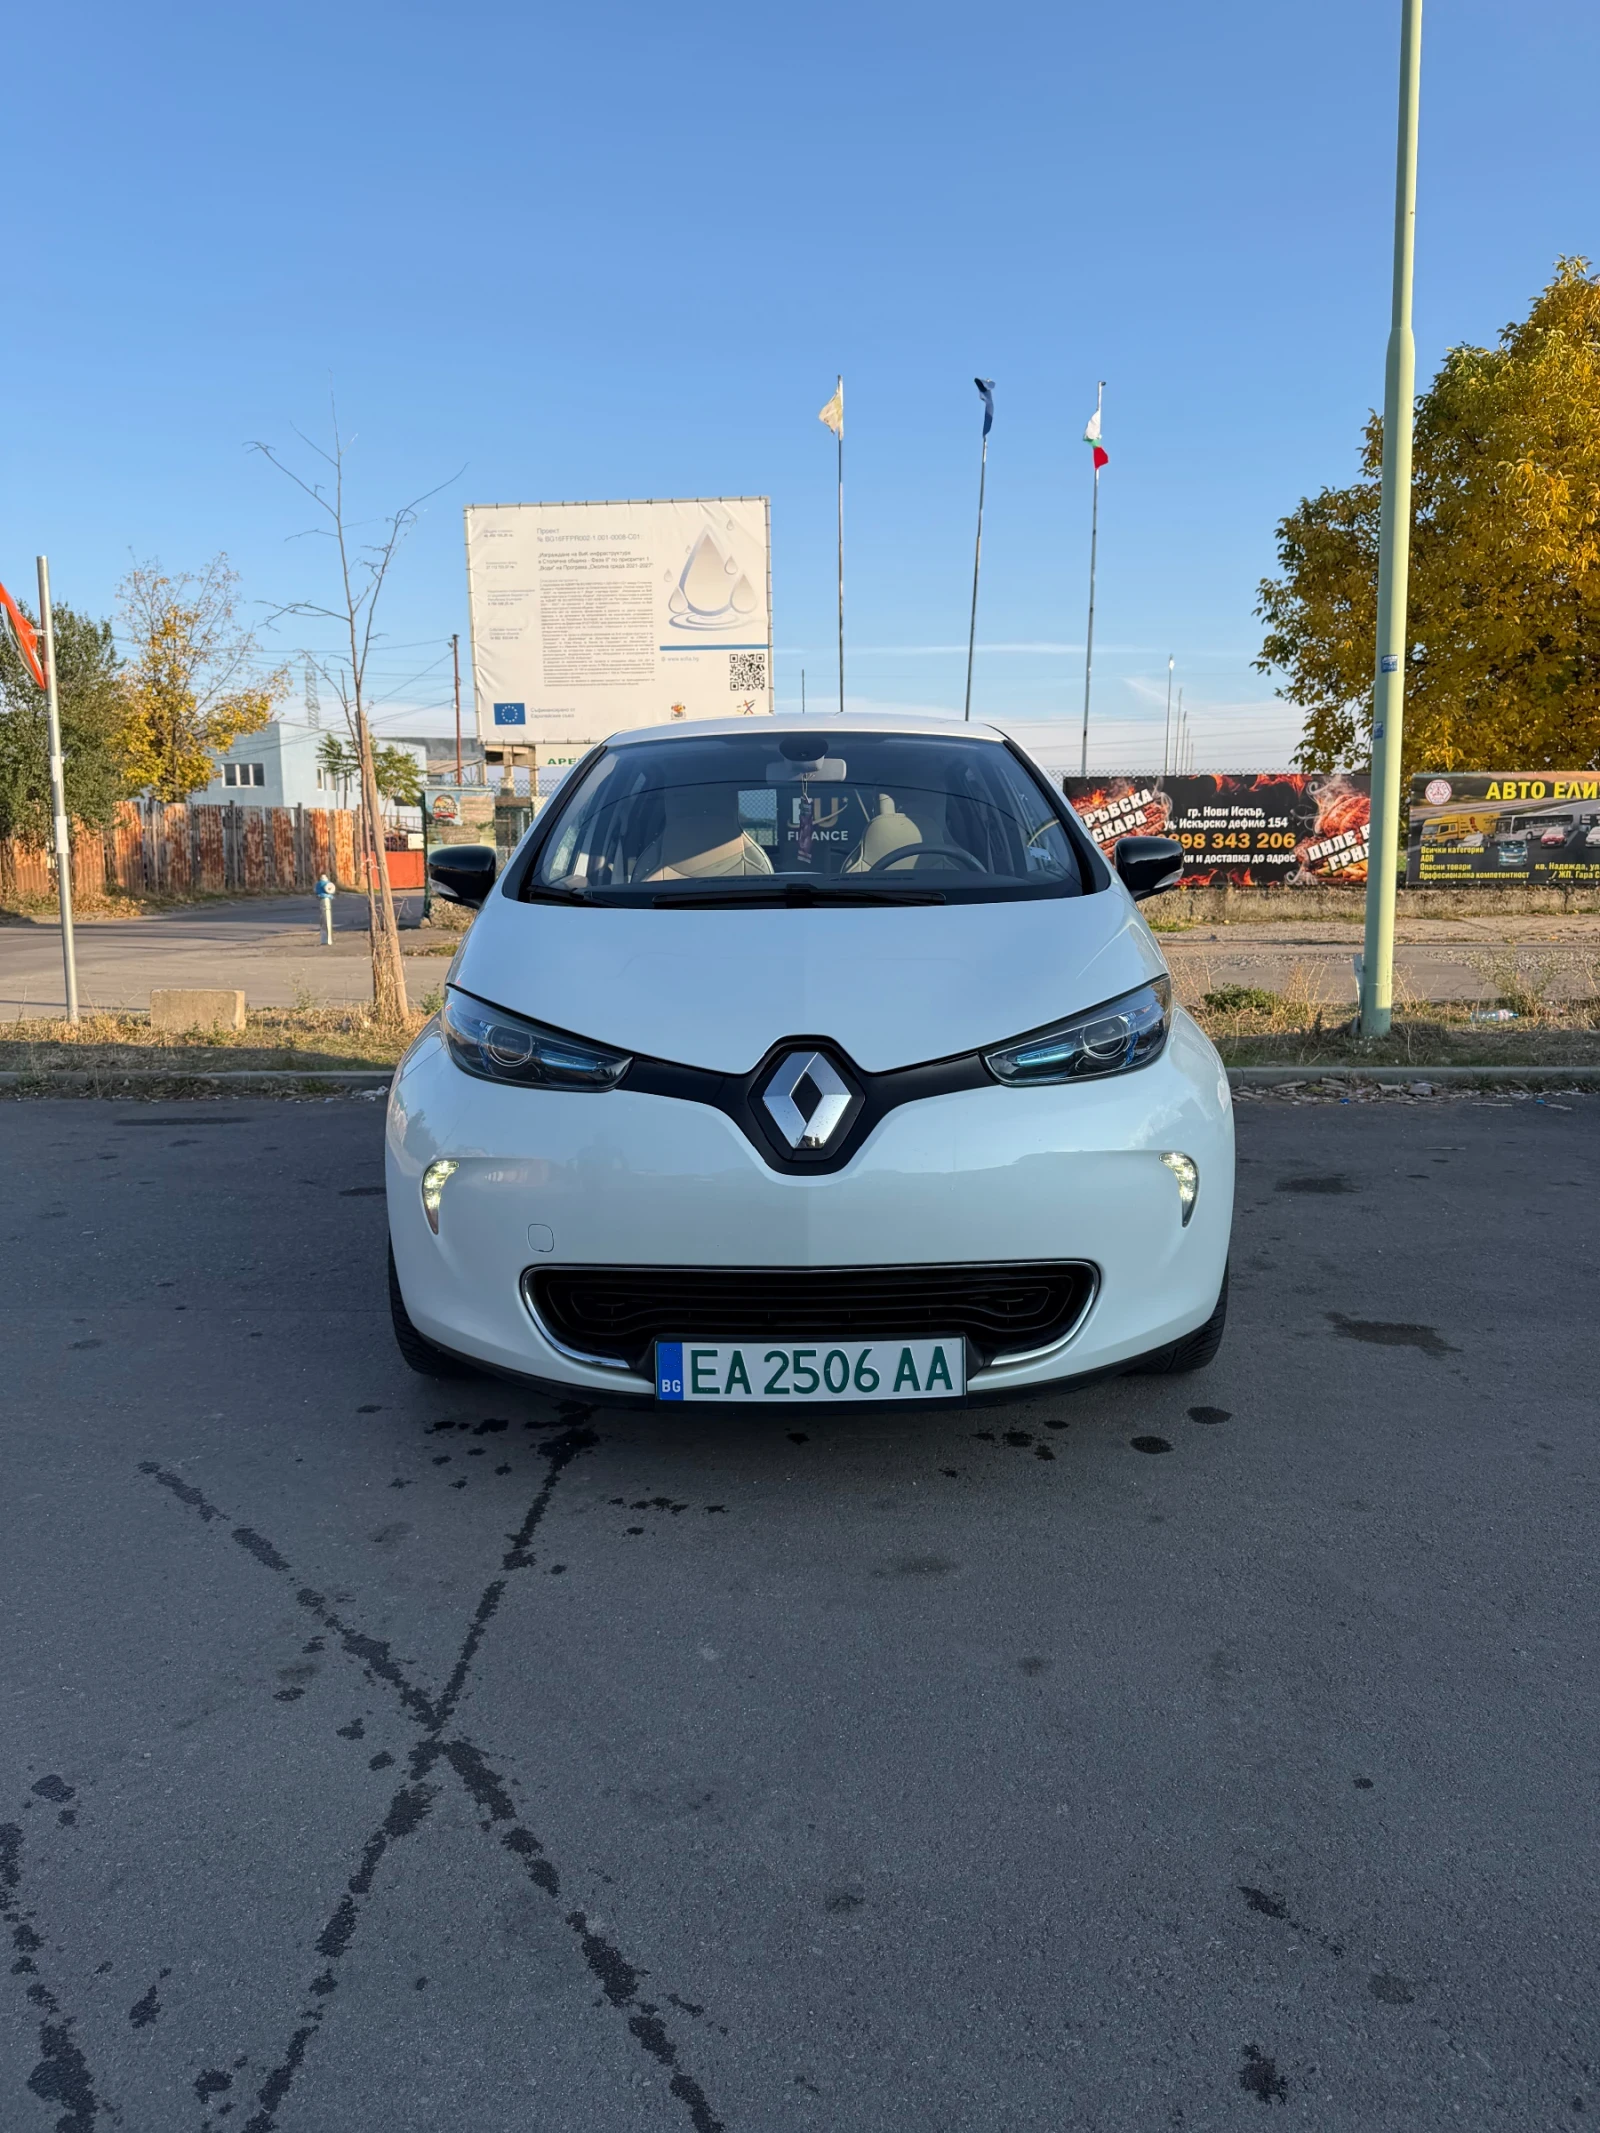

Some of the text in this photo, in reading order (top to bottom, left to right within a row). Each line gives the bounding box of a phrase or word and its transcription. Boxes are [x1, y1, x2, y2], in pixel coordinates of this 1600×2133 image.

[1485, 781, 1546, 800] АВТО
[1080, 788, 1153, 828] РЪБСКА
[1187, 806, 1265, 819] гр. Нови Искър,
[1091, 810, 1148, 843] СКАРА
[1164, 817, 1288, 831] ул. Искърско дефиле 154
[787, 830, 849, 841] FIANCE
[1211, 832, 1251, 849] 343
[1256, 832, 1296, 849] 206
[1307, 823, 1370, 861] ПИЛЕ Н
[1420, 846, 1484, 855] Всички категории
[1196, 854, 1203, 863] и
[1204, 854, 1250, 864] доставка
[1252, 854, 1264, 864] до
[1266, 854, 1296, 864] адрес
[1420, 863, 1446, 871] Опасни
[1419, 871, 1475, 880] Професионална
[1575, 871, 1593, 879] Гара
[691, 1345, 954, 1395] EA 2506 AA
[661, 1379, 681, 1393] BG
